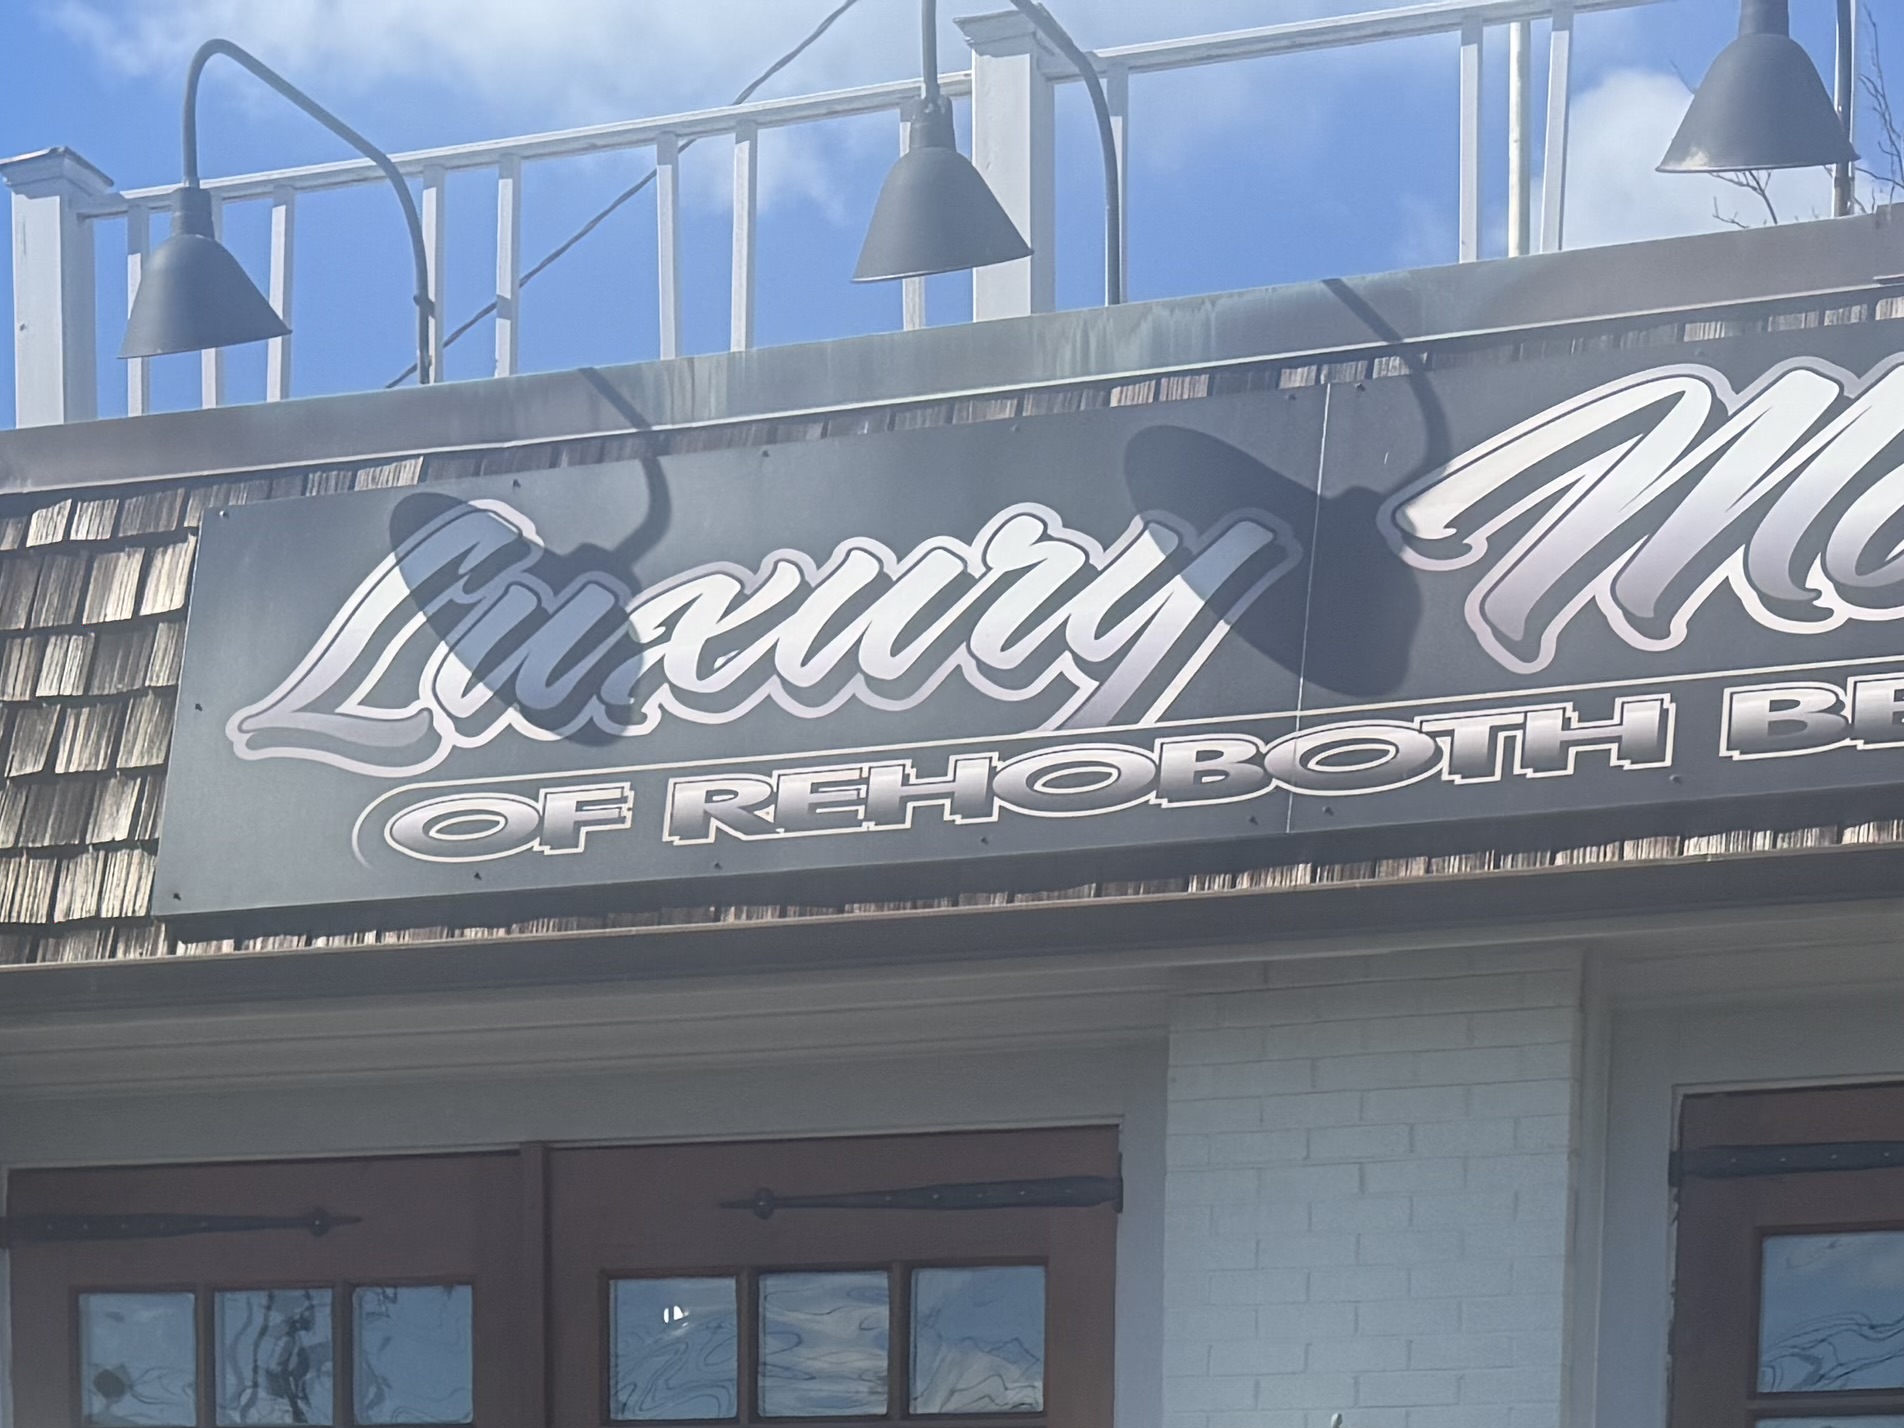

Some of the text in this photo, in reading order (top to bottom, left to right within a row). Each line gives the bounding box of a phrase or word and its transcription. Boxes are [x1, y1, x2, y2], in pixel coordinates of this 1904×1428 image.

[226, 500, 1303, 776] Luxury
[385, 782, 632, 862] OF
[662, 693, 1674, 846] REHOBOTH
